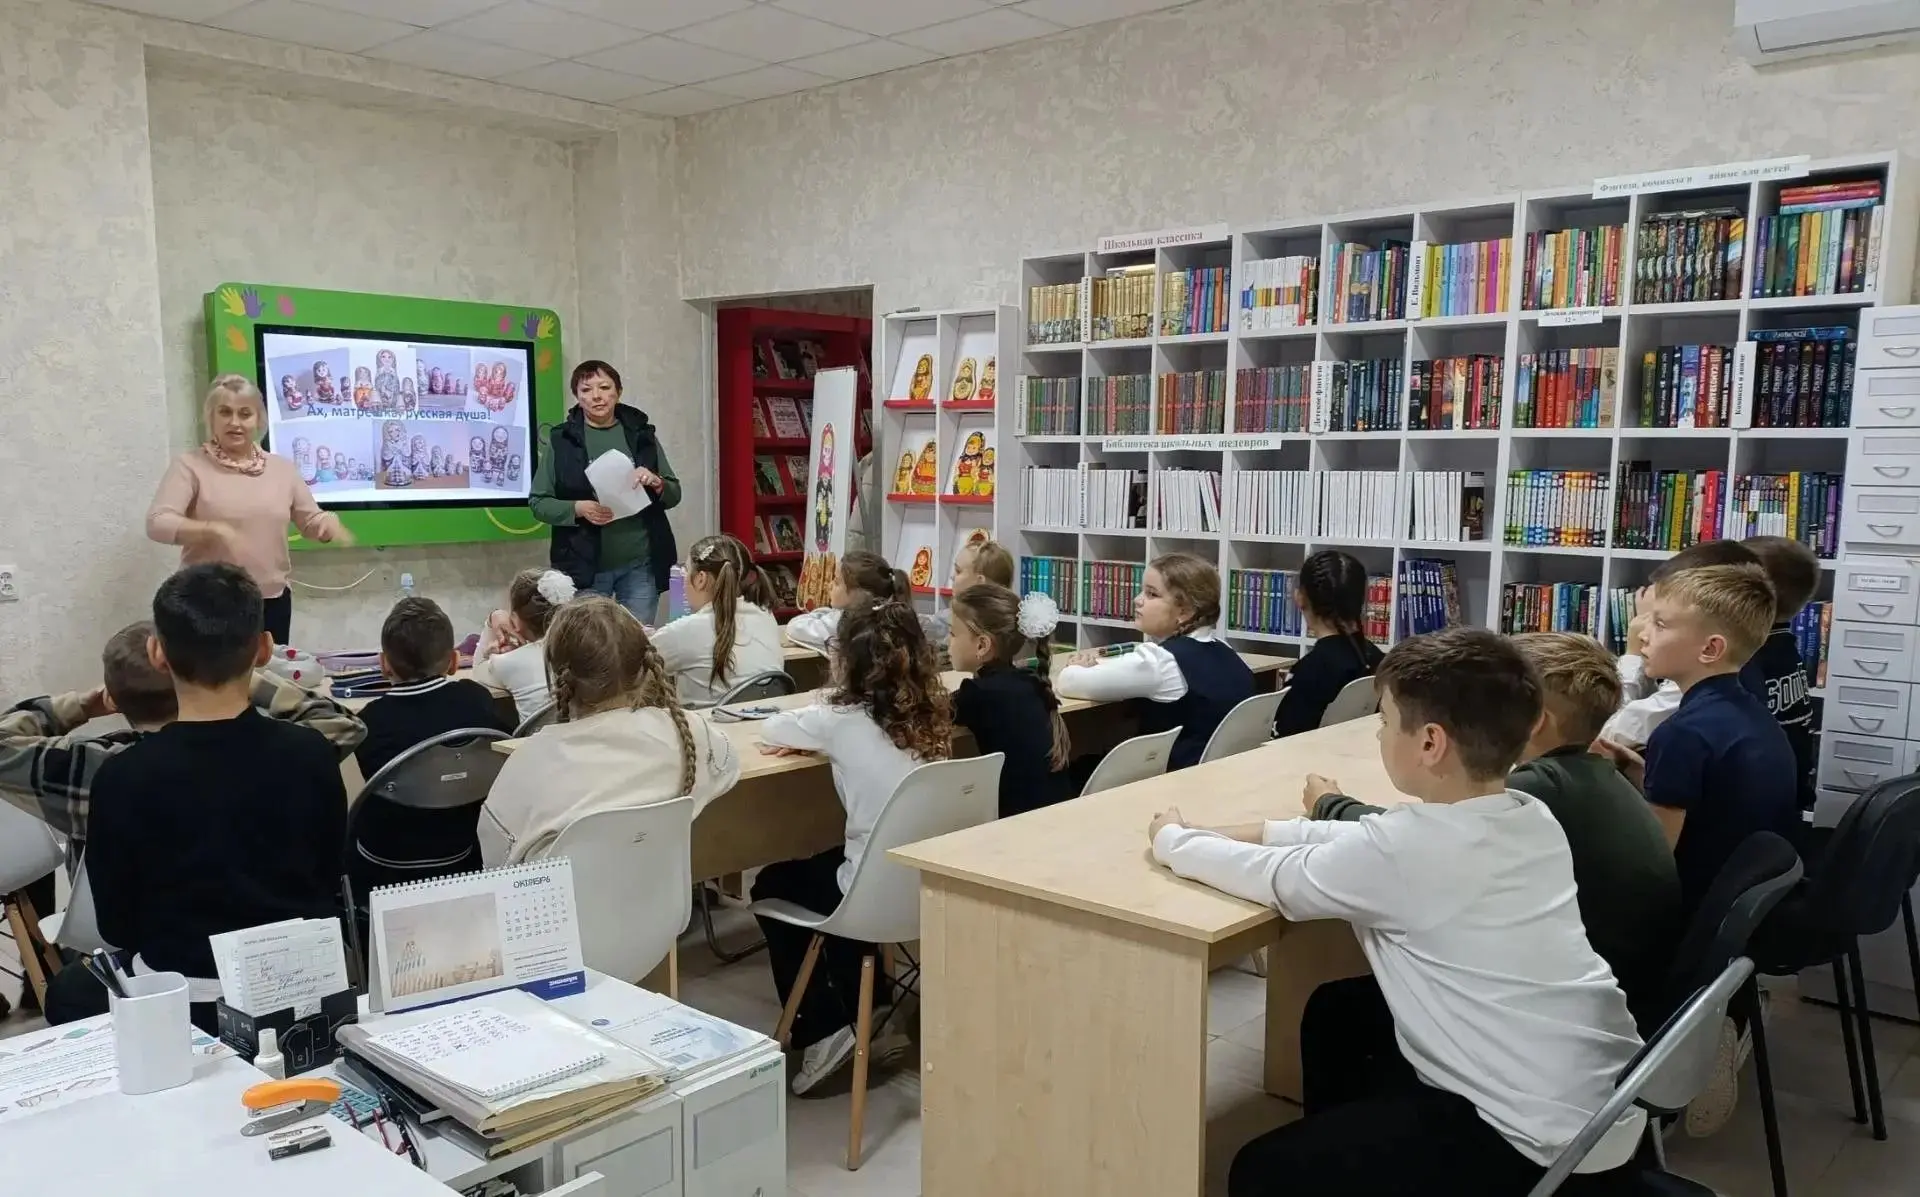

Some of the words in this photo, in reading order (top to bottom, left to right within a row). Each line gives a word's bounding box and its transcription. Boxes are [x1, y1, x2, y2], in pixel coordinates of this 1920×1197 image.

[1103, 238, 1154, 250] Школьная
[1156, 232, 1203, 245] классика
[307, 403, 328, 419] Ах,
[405, 409, 453, 421] русская
[455, 405, 492, 421] душа!
[1105, 439, 1159, 449] Библиотека
[1161, 439, 1212, 449] школьных
[1218, 438, 1269, 450] шедевров
[513, 876, 551, 889] ОКТЯБРЬ
